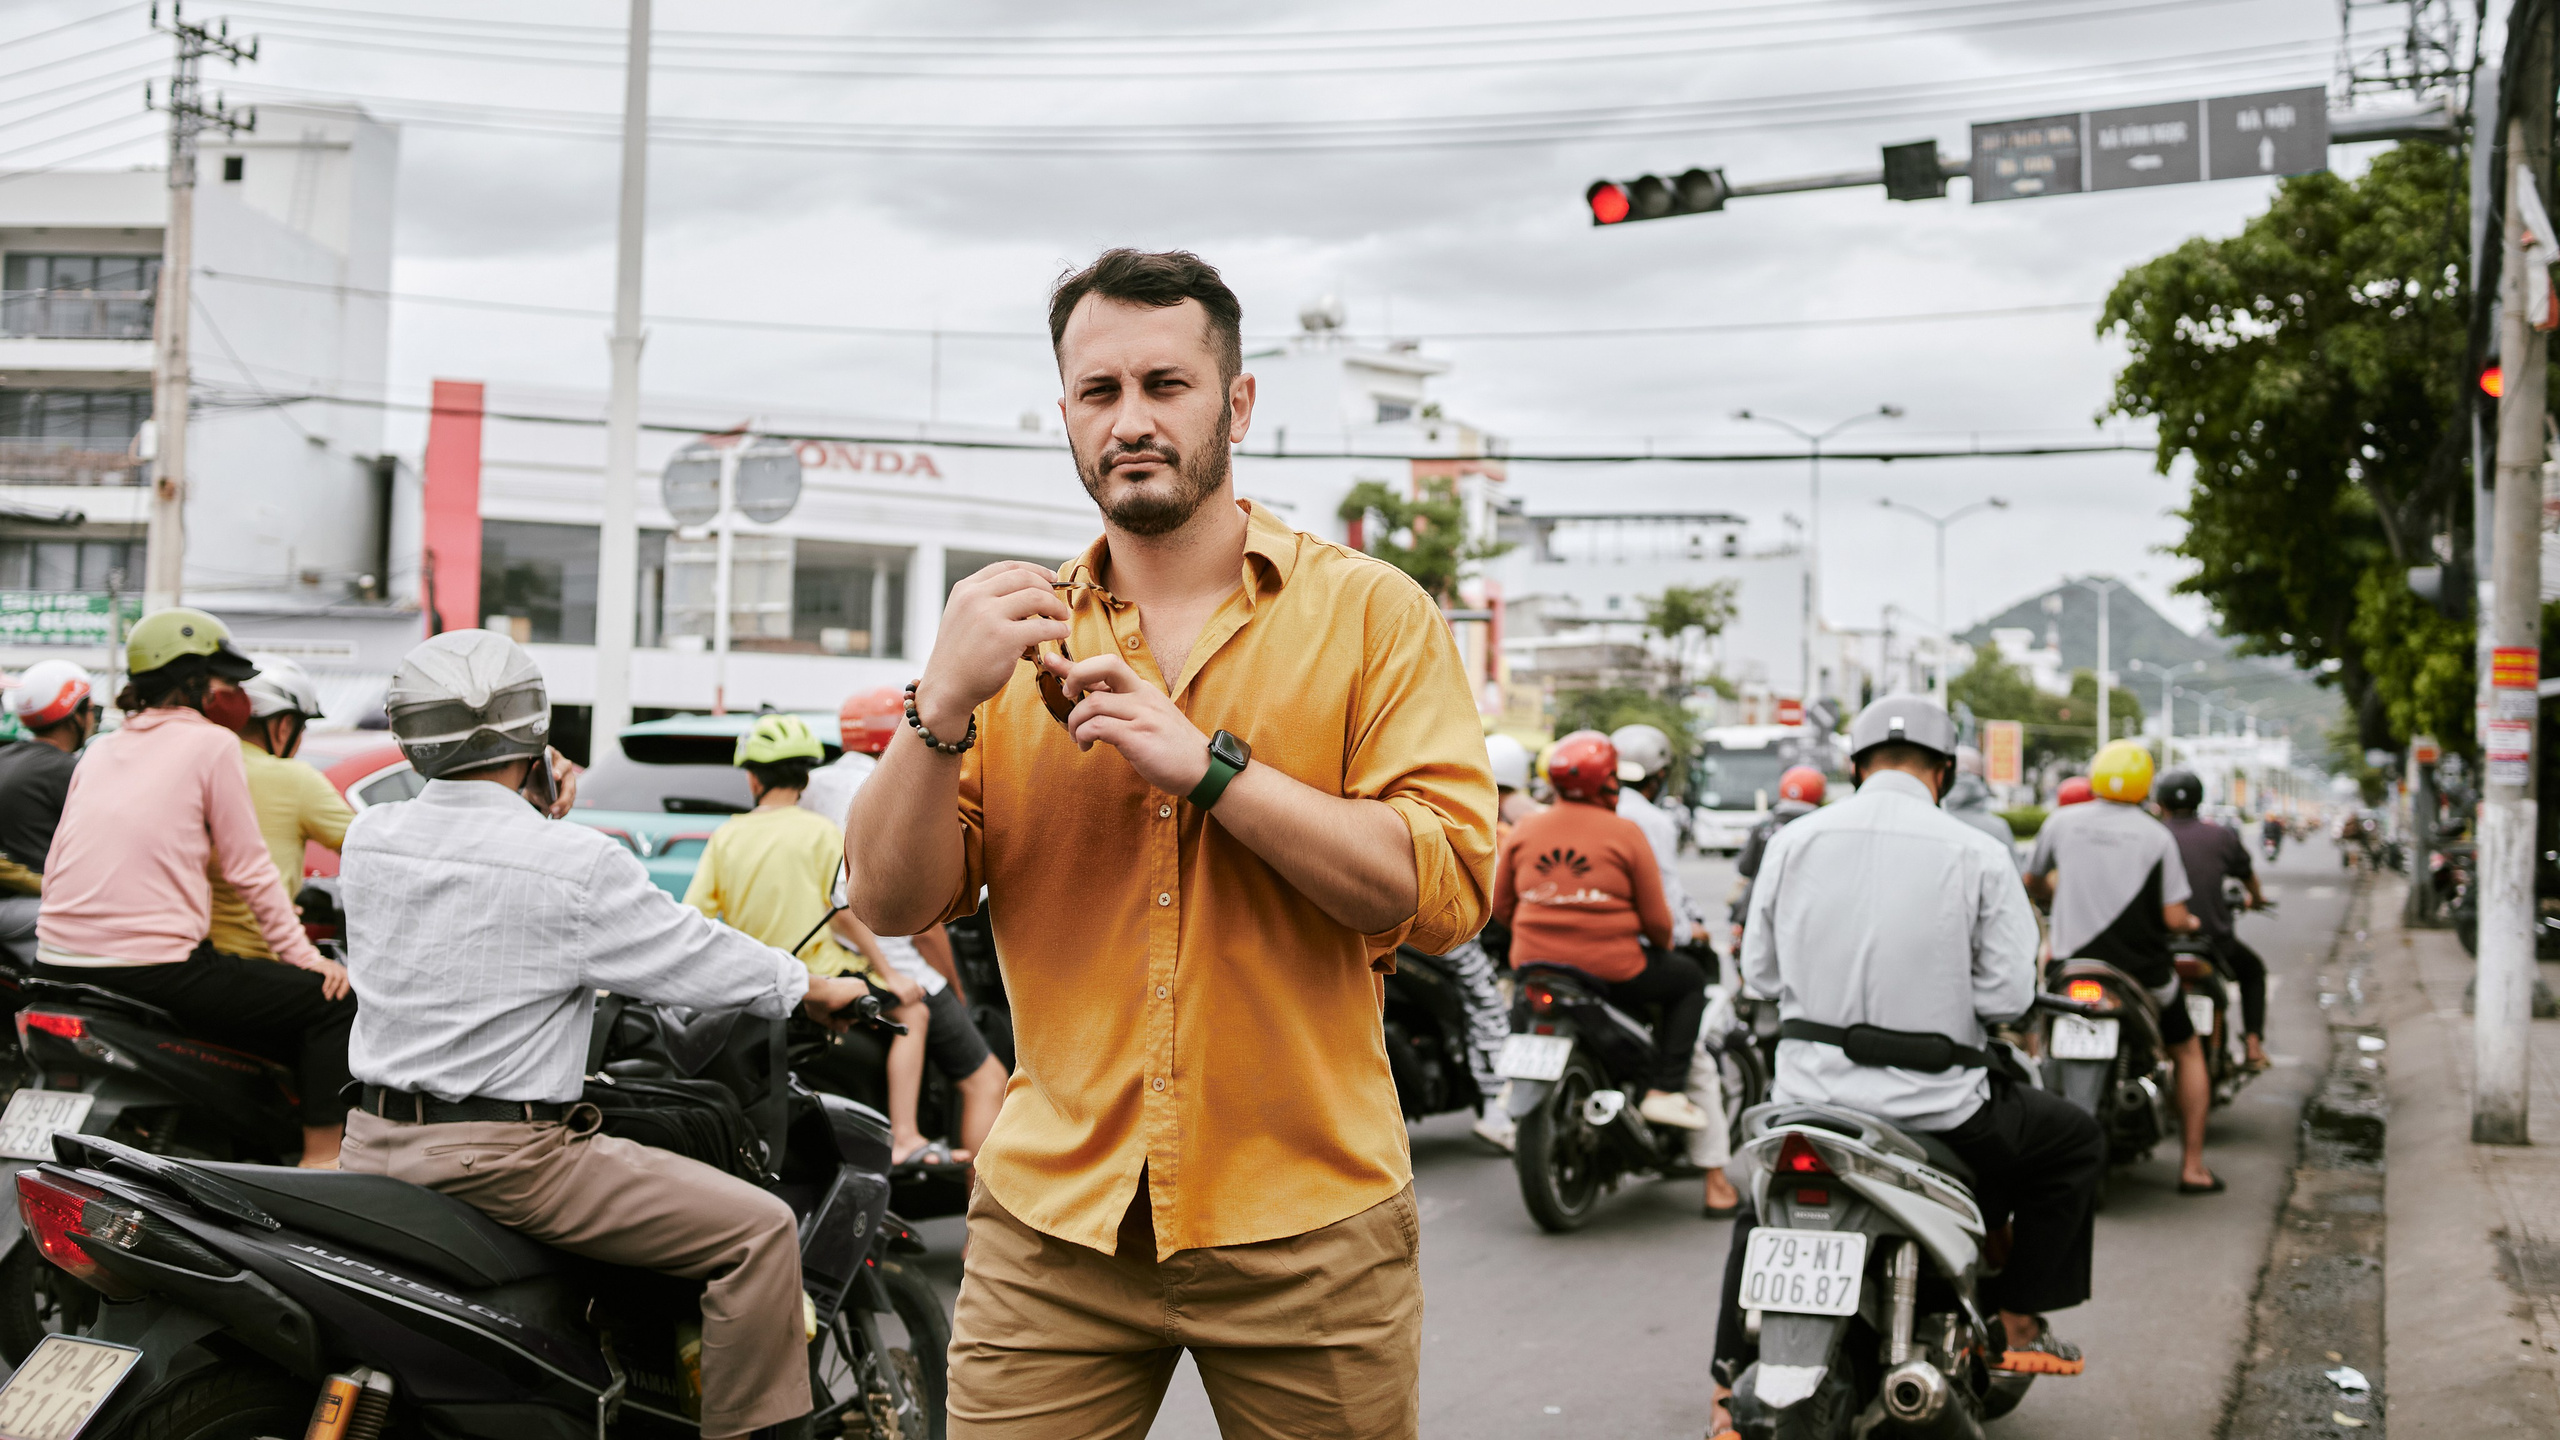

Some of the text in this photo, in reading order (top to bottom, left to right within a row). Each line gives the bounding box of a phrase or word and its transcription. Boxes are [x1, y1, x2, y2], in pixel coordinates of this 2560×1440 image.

[797, 440, 942, 478] ONDA
[1794, 1211, 1830, 1221] HONDA
[1766, 1238, 1844, 1272] 79-N1
[287, 1243, 464, 1306] JUPITER
[1751, 1271, 1852, 1308] 006.87
[27, 1343, 119, 1393] 79-N2
